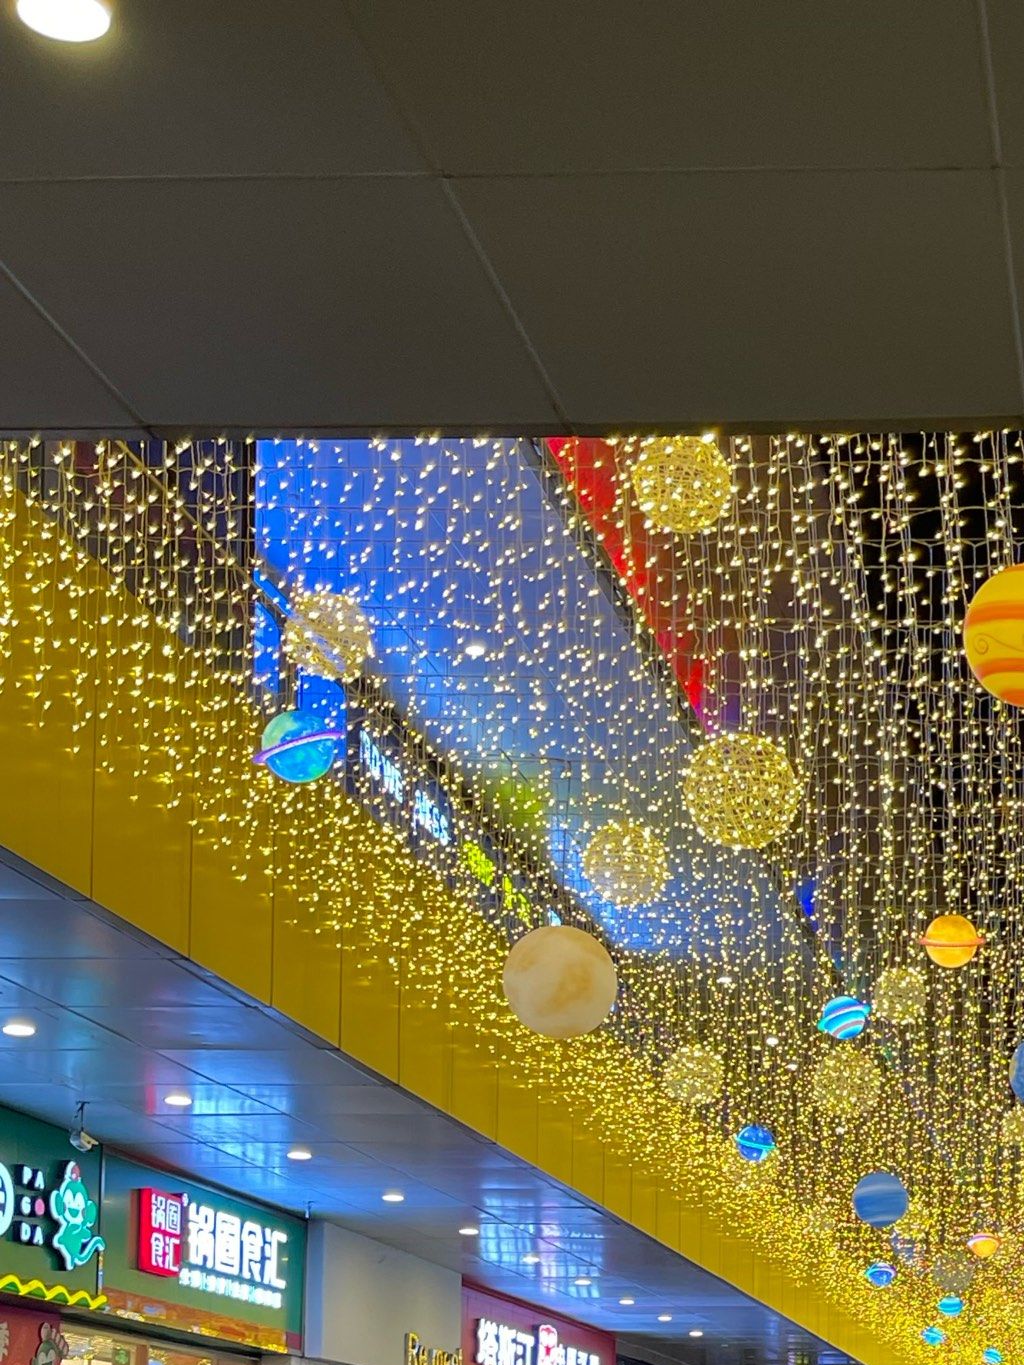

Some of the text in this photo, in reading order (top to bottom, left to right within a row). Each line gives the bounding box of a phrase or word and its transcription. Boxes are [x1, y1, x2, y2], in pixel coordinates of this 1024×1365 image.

[22, 1166, 45, 1189] PA
[20, 1222, 44, 1245] DA
[151, 1193, 181, 1235] 锅圈
[150, 1232, 180, 1271] 食汇
[188, 1202, 288, 1290] 锅圈食汇
